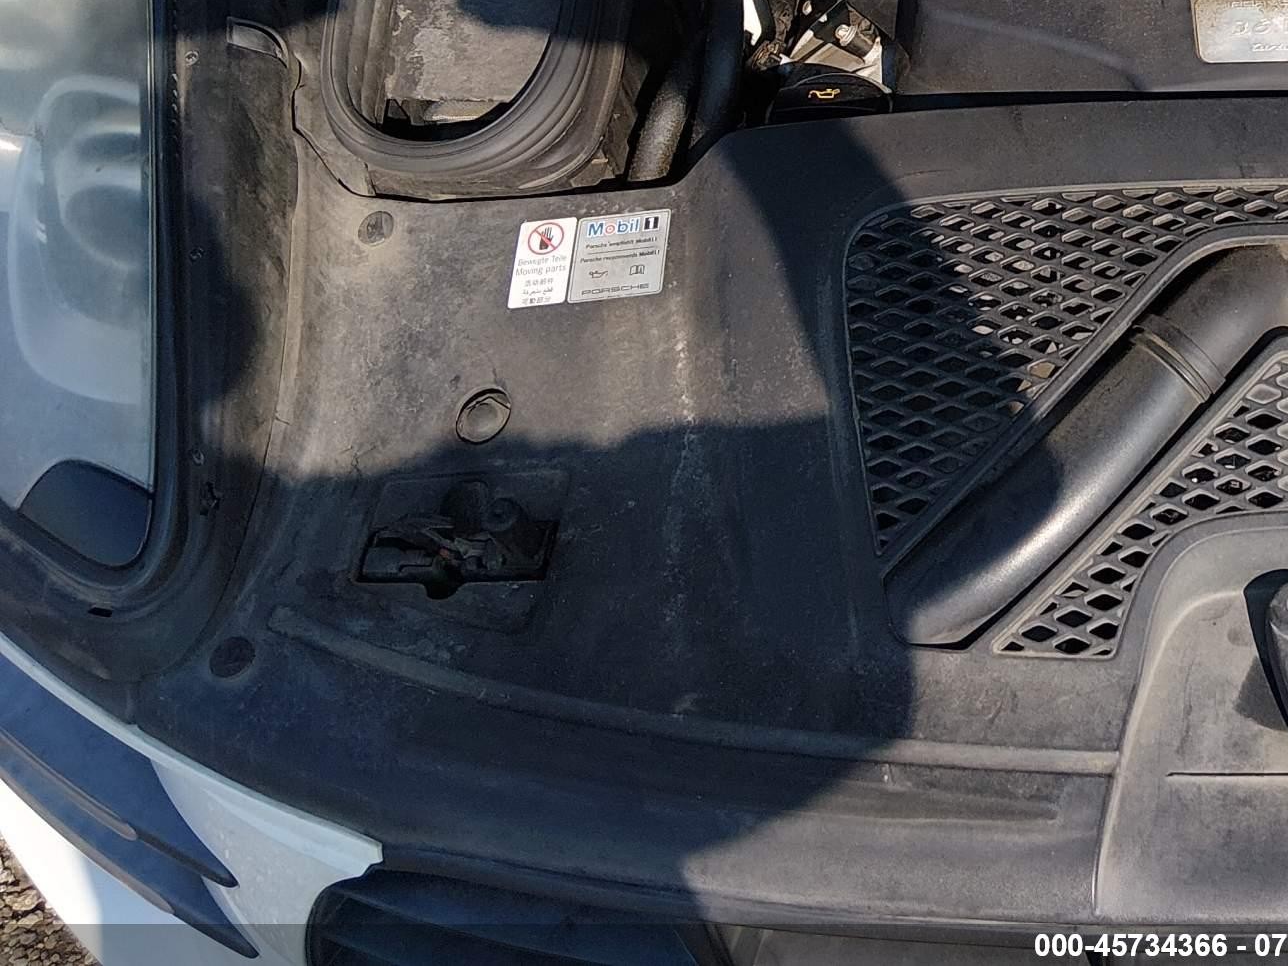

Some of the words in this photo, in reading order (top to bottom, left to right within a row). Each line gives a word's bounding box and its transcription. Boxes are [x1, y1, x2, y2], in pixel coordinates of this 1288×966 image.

[588, 218, 640, 236] Mobil
[643, 216, 660, 230] 1
[518, 255, 550, 266] Bewegte
[516, 266, 543, 276] Moving
[546, 265, 567, 275] parts
[581, 283, 649, 296] PORSCHE
